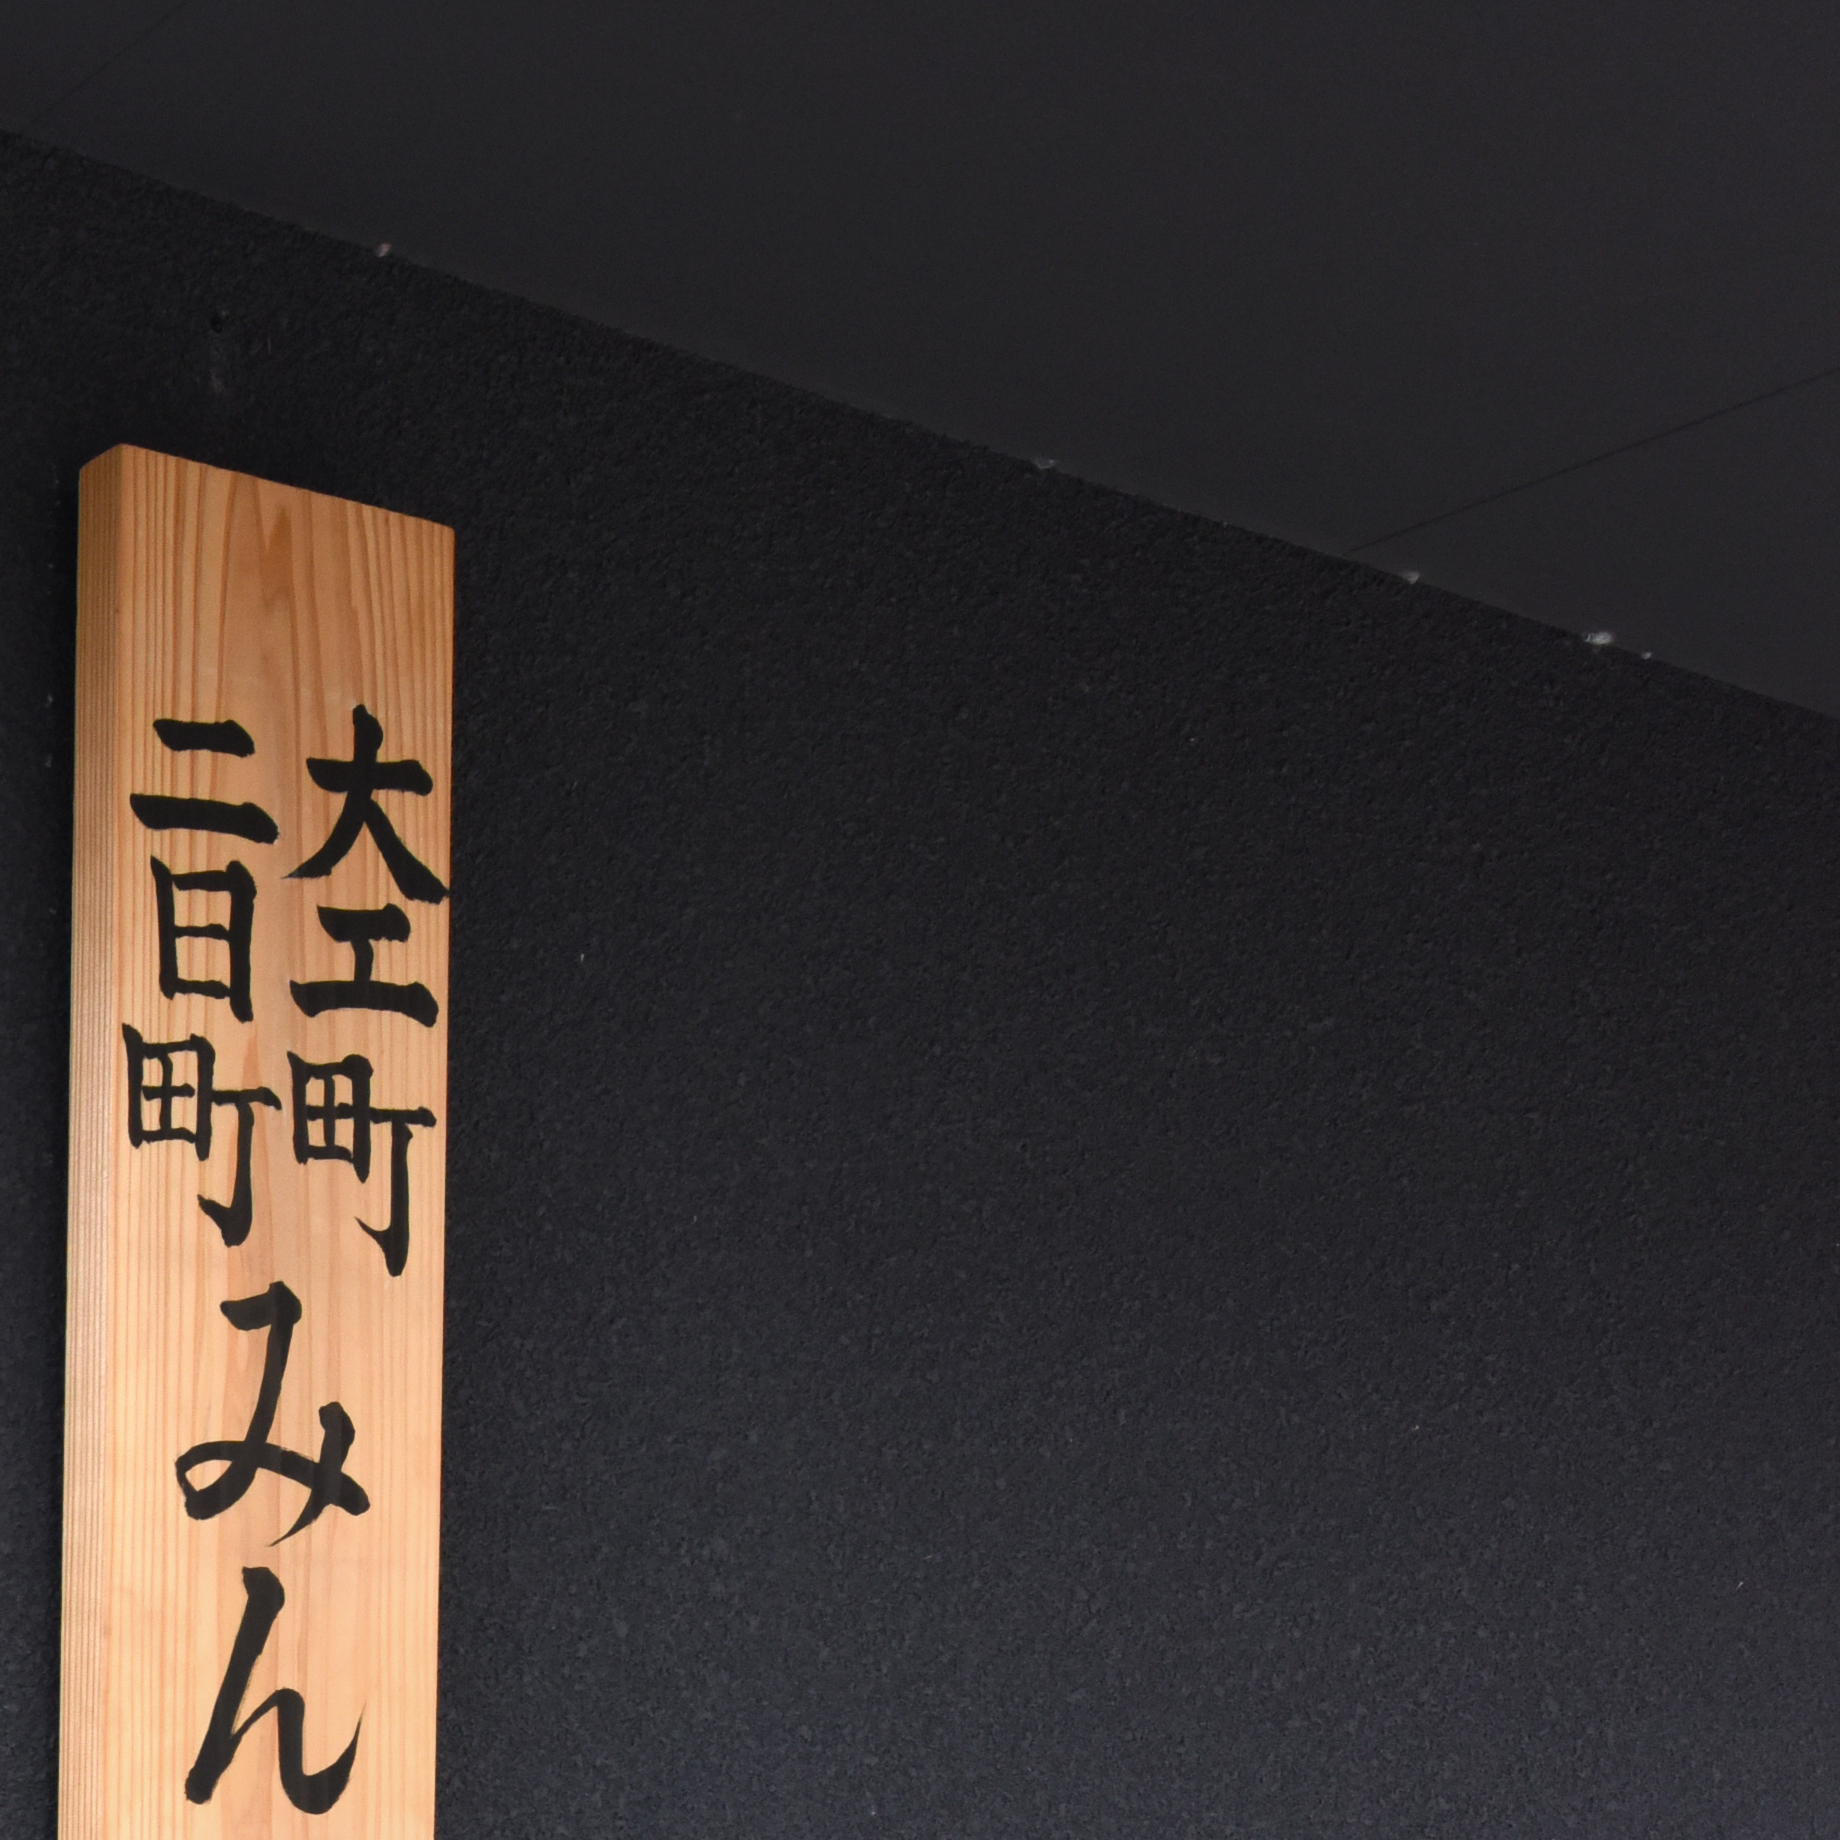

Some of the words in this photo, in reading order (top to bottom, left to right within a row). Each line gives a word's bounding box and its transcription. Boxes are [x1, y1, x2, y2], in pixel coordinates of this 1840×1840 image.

[122, 718, 283, 1248] 二日町
[281, 704, 450, 1278] 大工町
